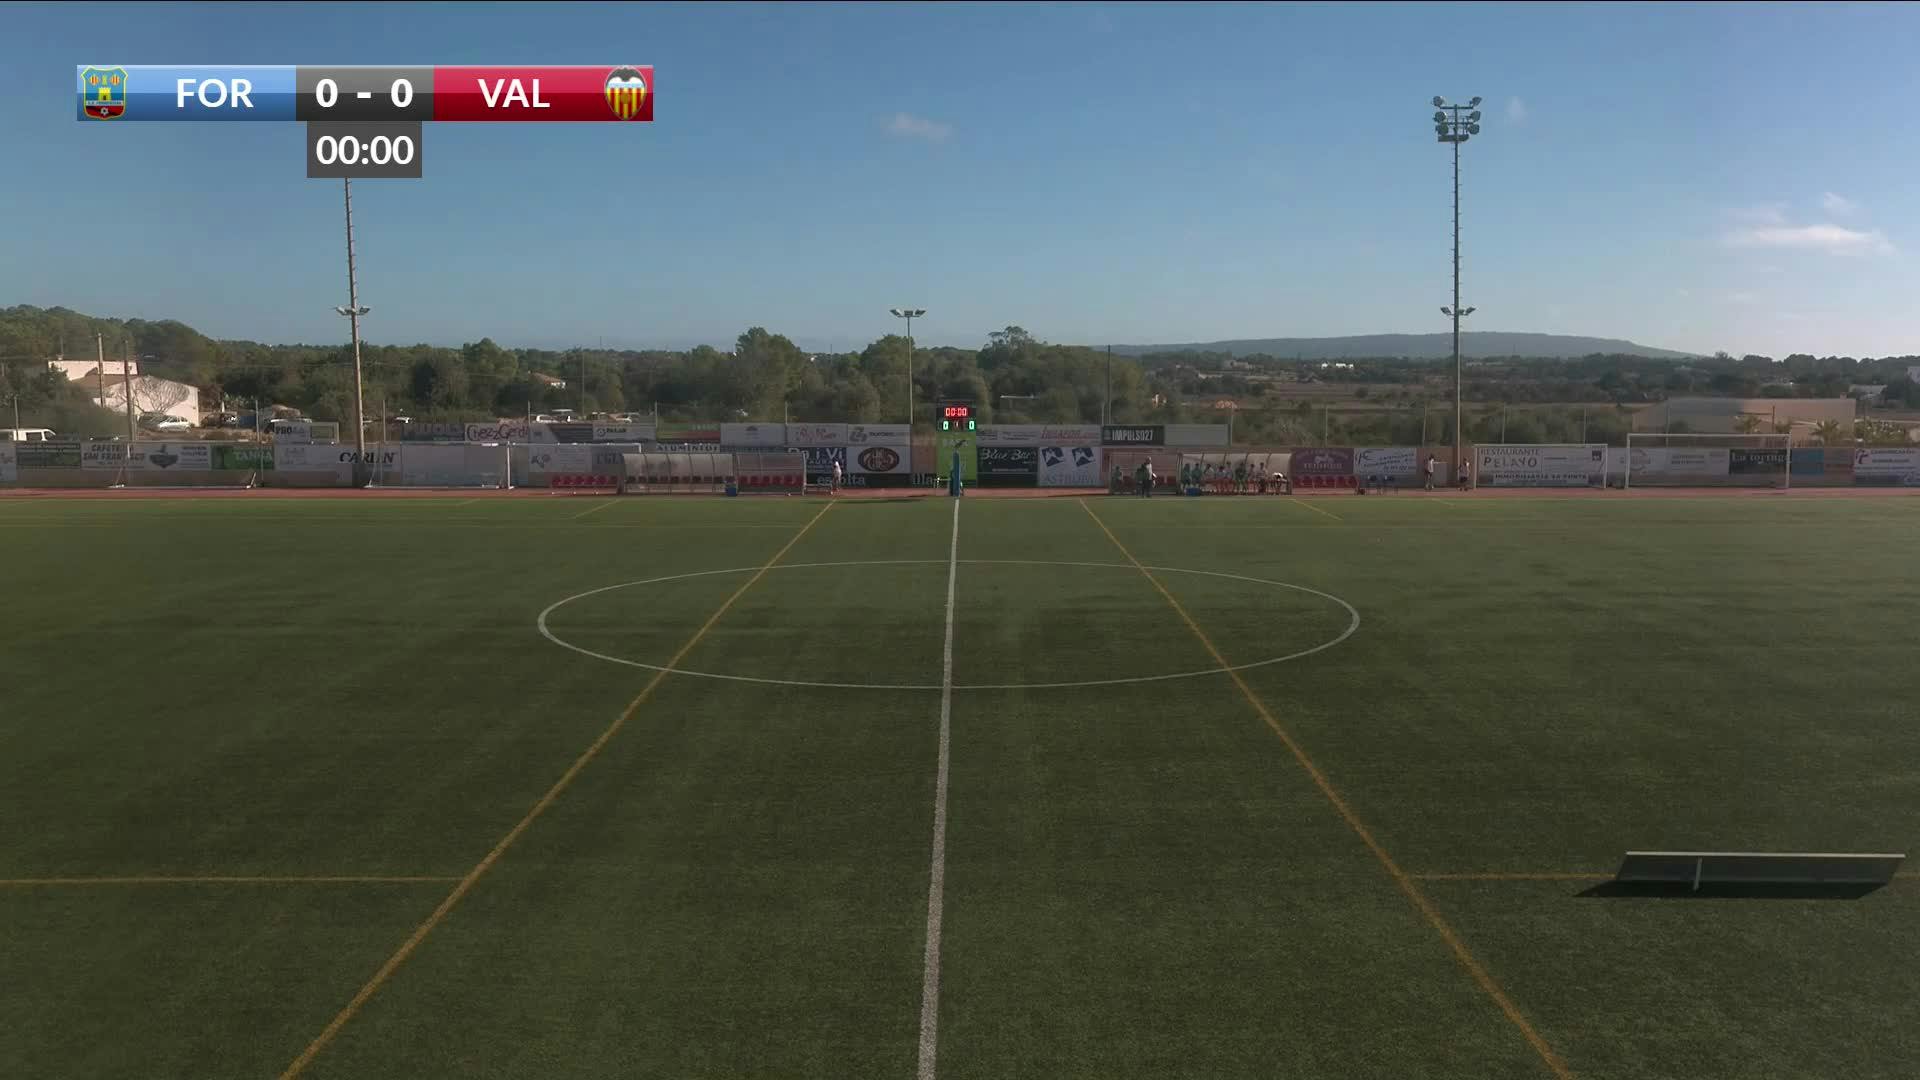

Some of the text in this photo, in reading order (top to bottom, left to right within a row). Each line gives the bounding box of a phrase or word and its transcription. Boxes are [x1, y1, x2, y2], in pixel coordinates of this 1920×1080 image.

[945, 407, 967, 417] 00:00
[92, 444, 135, 452] CAFETEA
[1485, 456, 1538, 468] PELAYO
[1749, 453, 1791, 465] tortug
